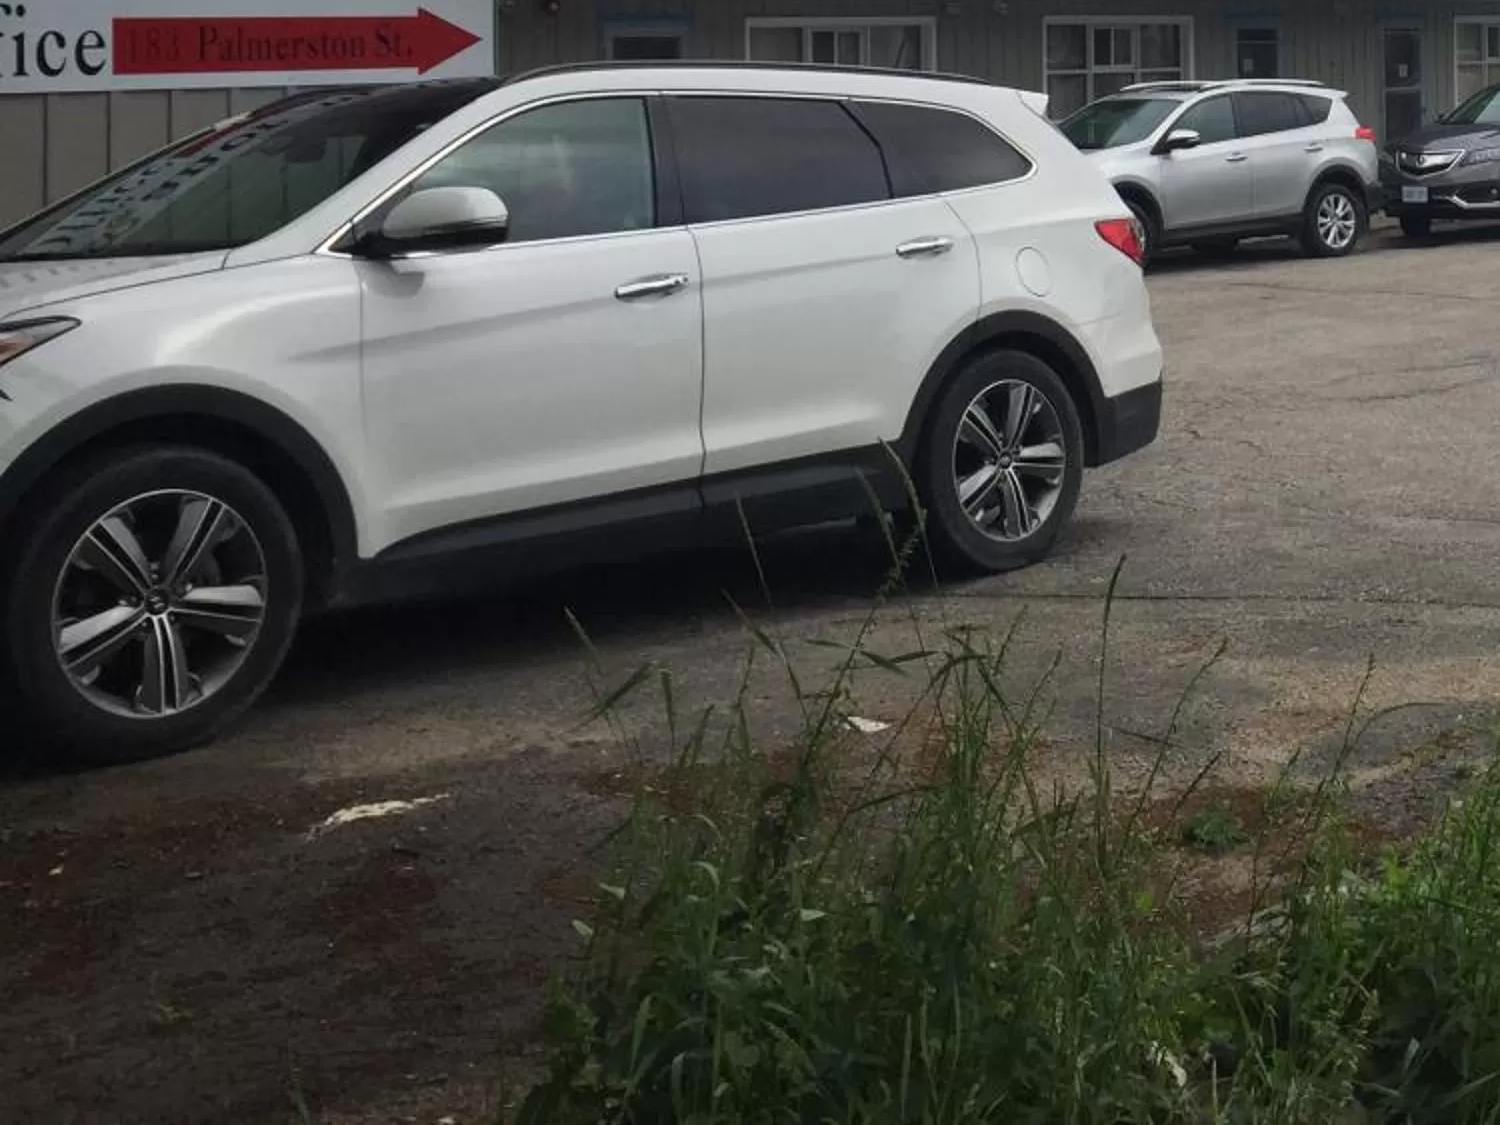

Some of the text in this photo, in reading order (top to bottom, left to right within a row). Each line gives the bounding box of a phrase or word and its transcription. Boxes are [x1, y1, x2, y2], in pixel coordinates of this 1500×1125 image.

[126, 21, 414, 64] 183 Palmerston St.
